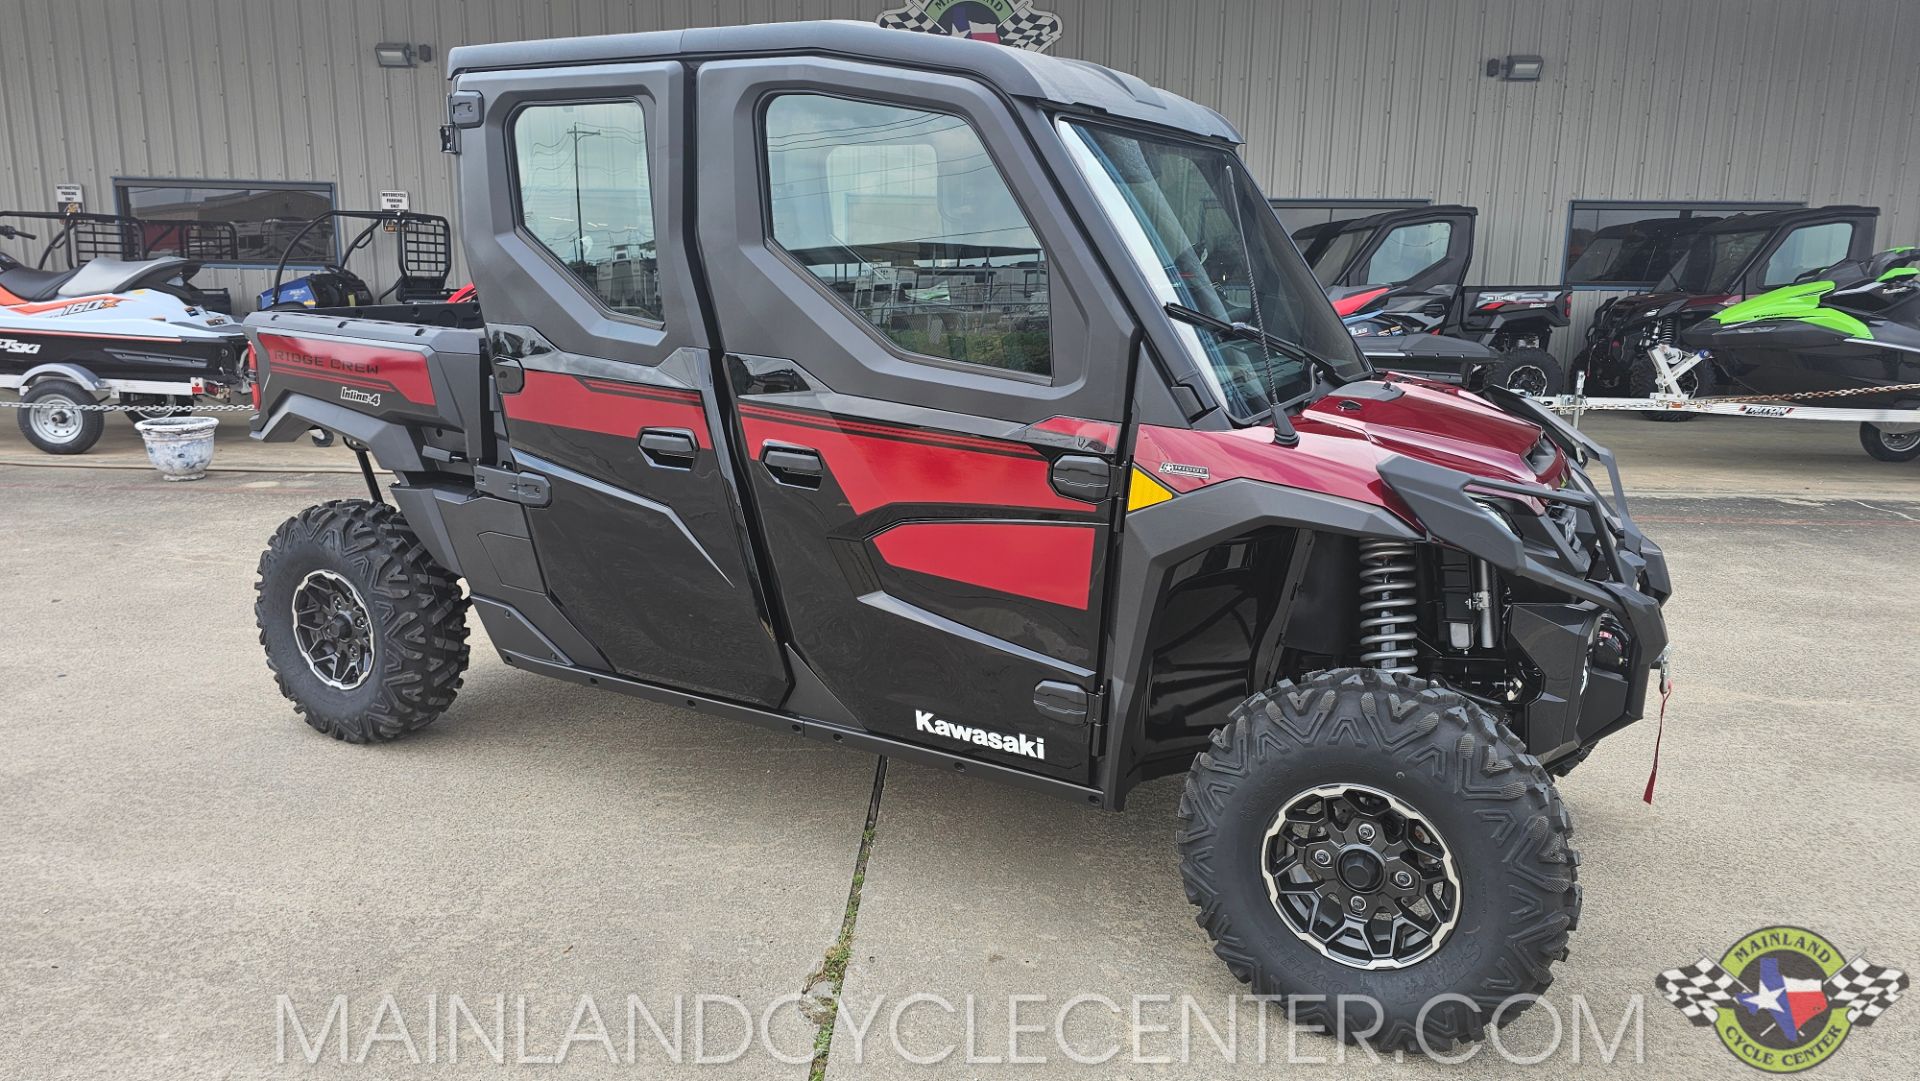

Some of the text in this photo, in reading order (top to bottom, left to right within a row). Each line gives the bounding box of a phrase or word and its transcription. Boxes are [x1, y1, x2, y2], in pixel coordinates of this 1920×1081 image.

[274, 350, 380, 375] RIDGE CREW
[915, 709, 1045, 760] Kawasaki
